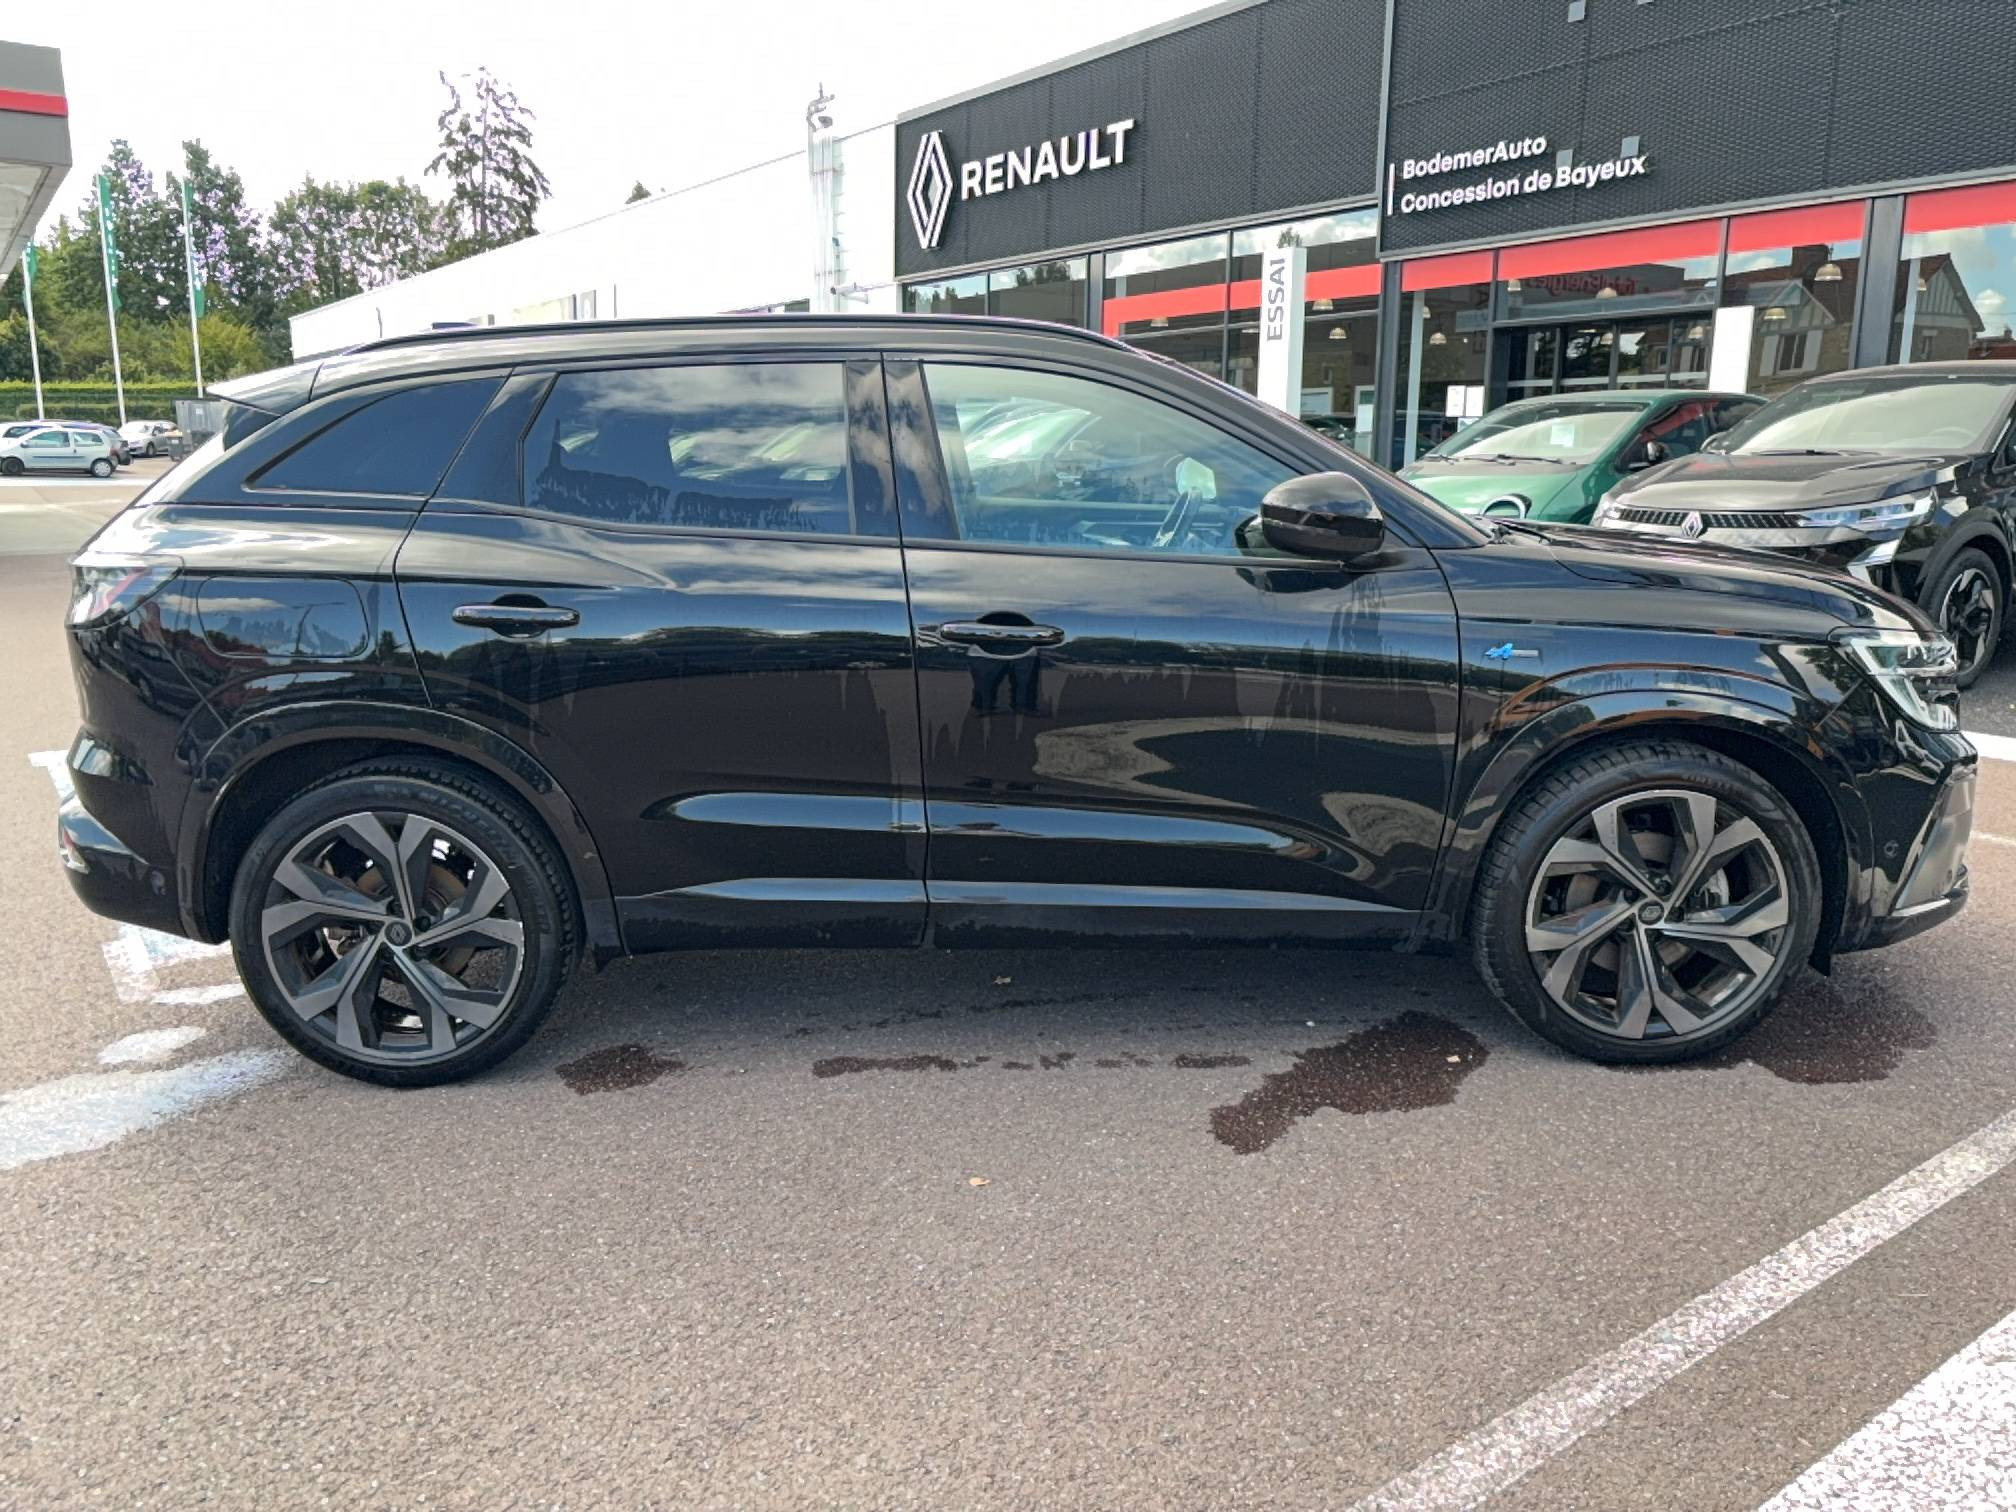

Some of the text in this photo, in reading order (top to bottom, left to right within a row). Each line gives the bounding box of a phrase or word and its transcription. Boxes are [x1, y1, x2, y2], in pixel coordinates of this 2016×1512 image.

[961, 118, 1135, 200] RENAULT
[1400, 155, 1647, 214] Concession de Bayeux
[1402, 136, 1547, 179] BodemerAuto
[1266, 258, 1286, 342] ESSAI
